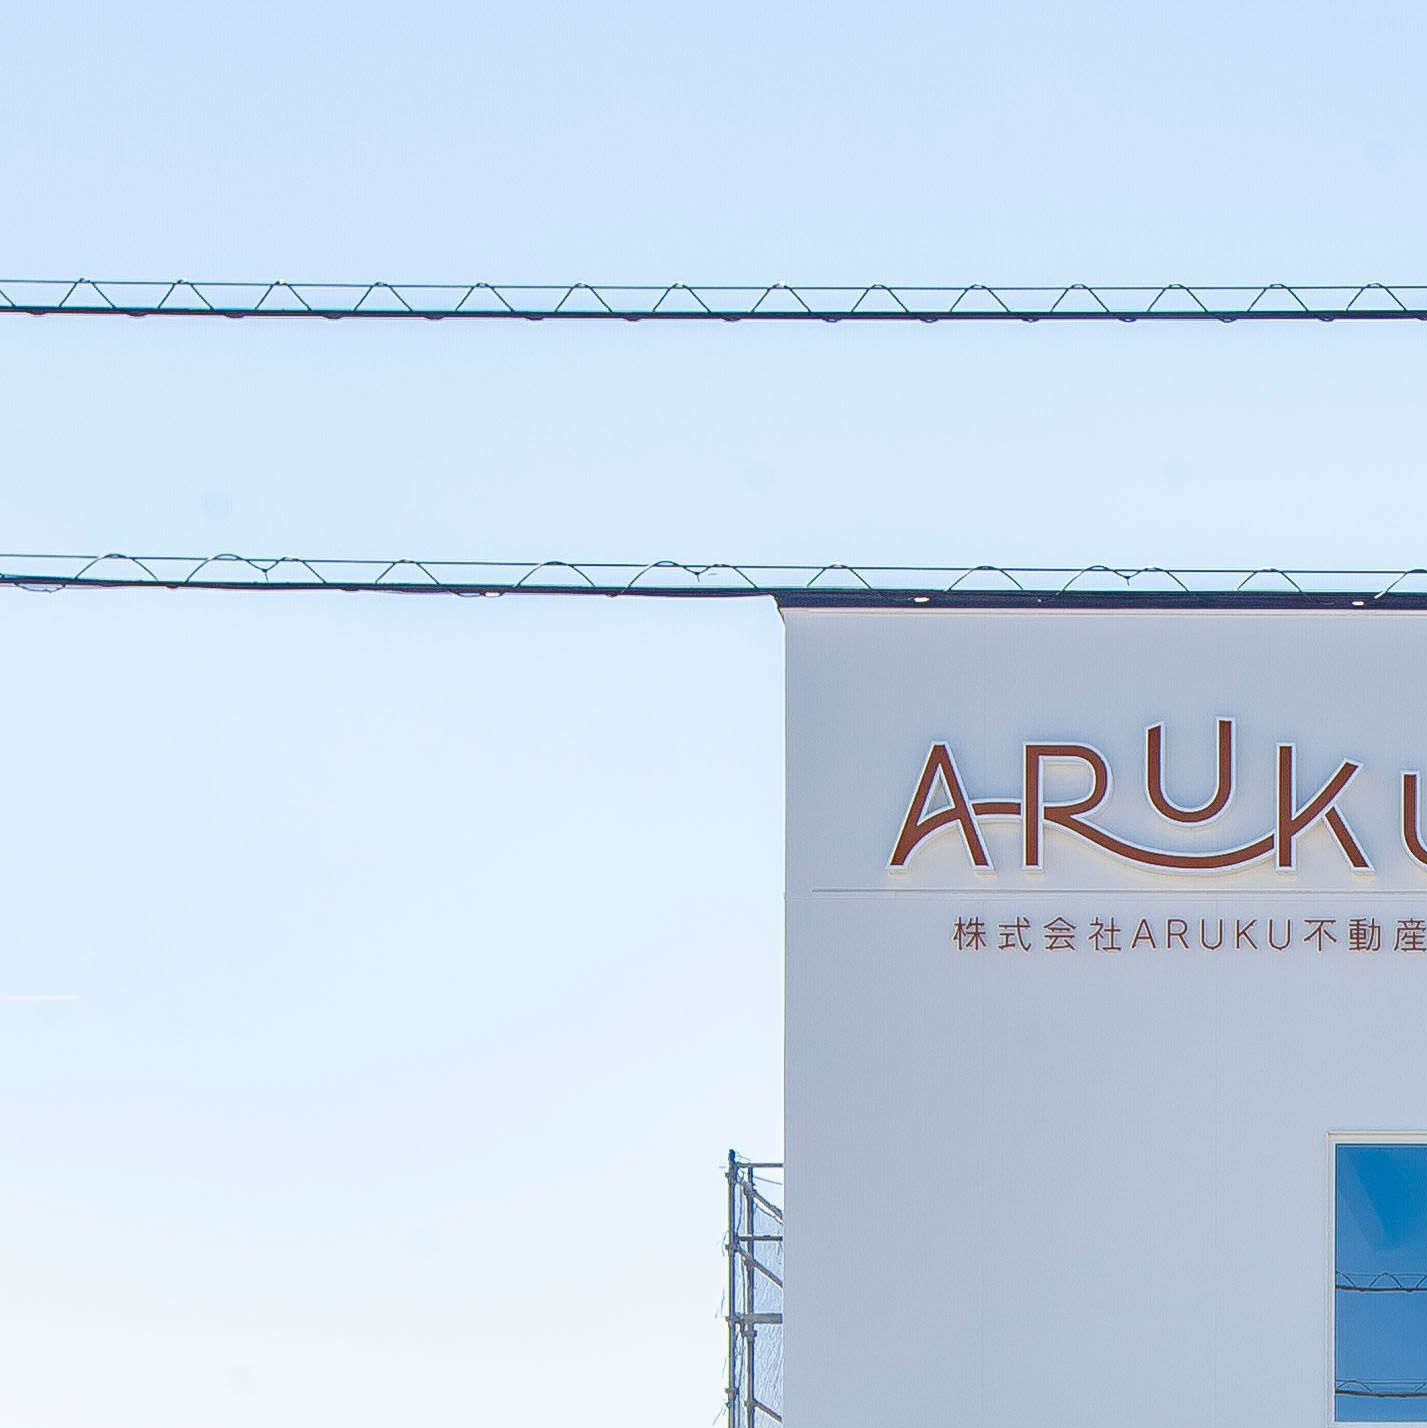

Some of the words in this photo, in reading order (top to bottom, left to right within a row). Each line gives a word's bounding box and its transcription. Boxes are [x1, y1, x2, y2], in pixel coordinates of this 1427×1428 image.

[952, 915, 1427, 953] 株式会社ARUKU不動産
